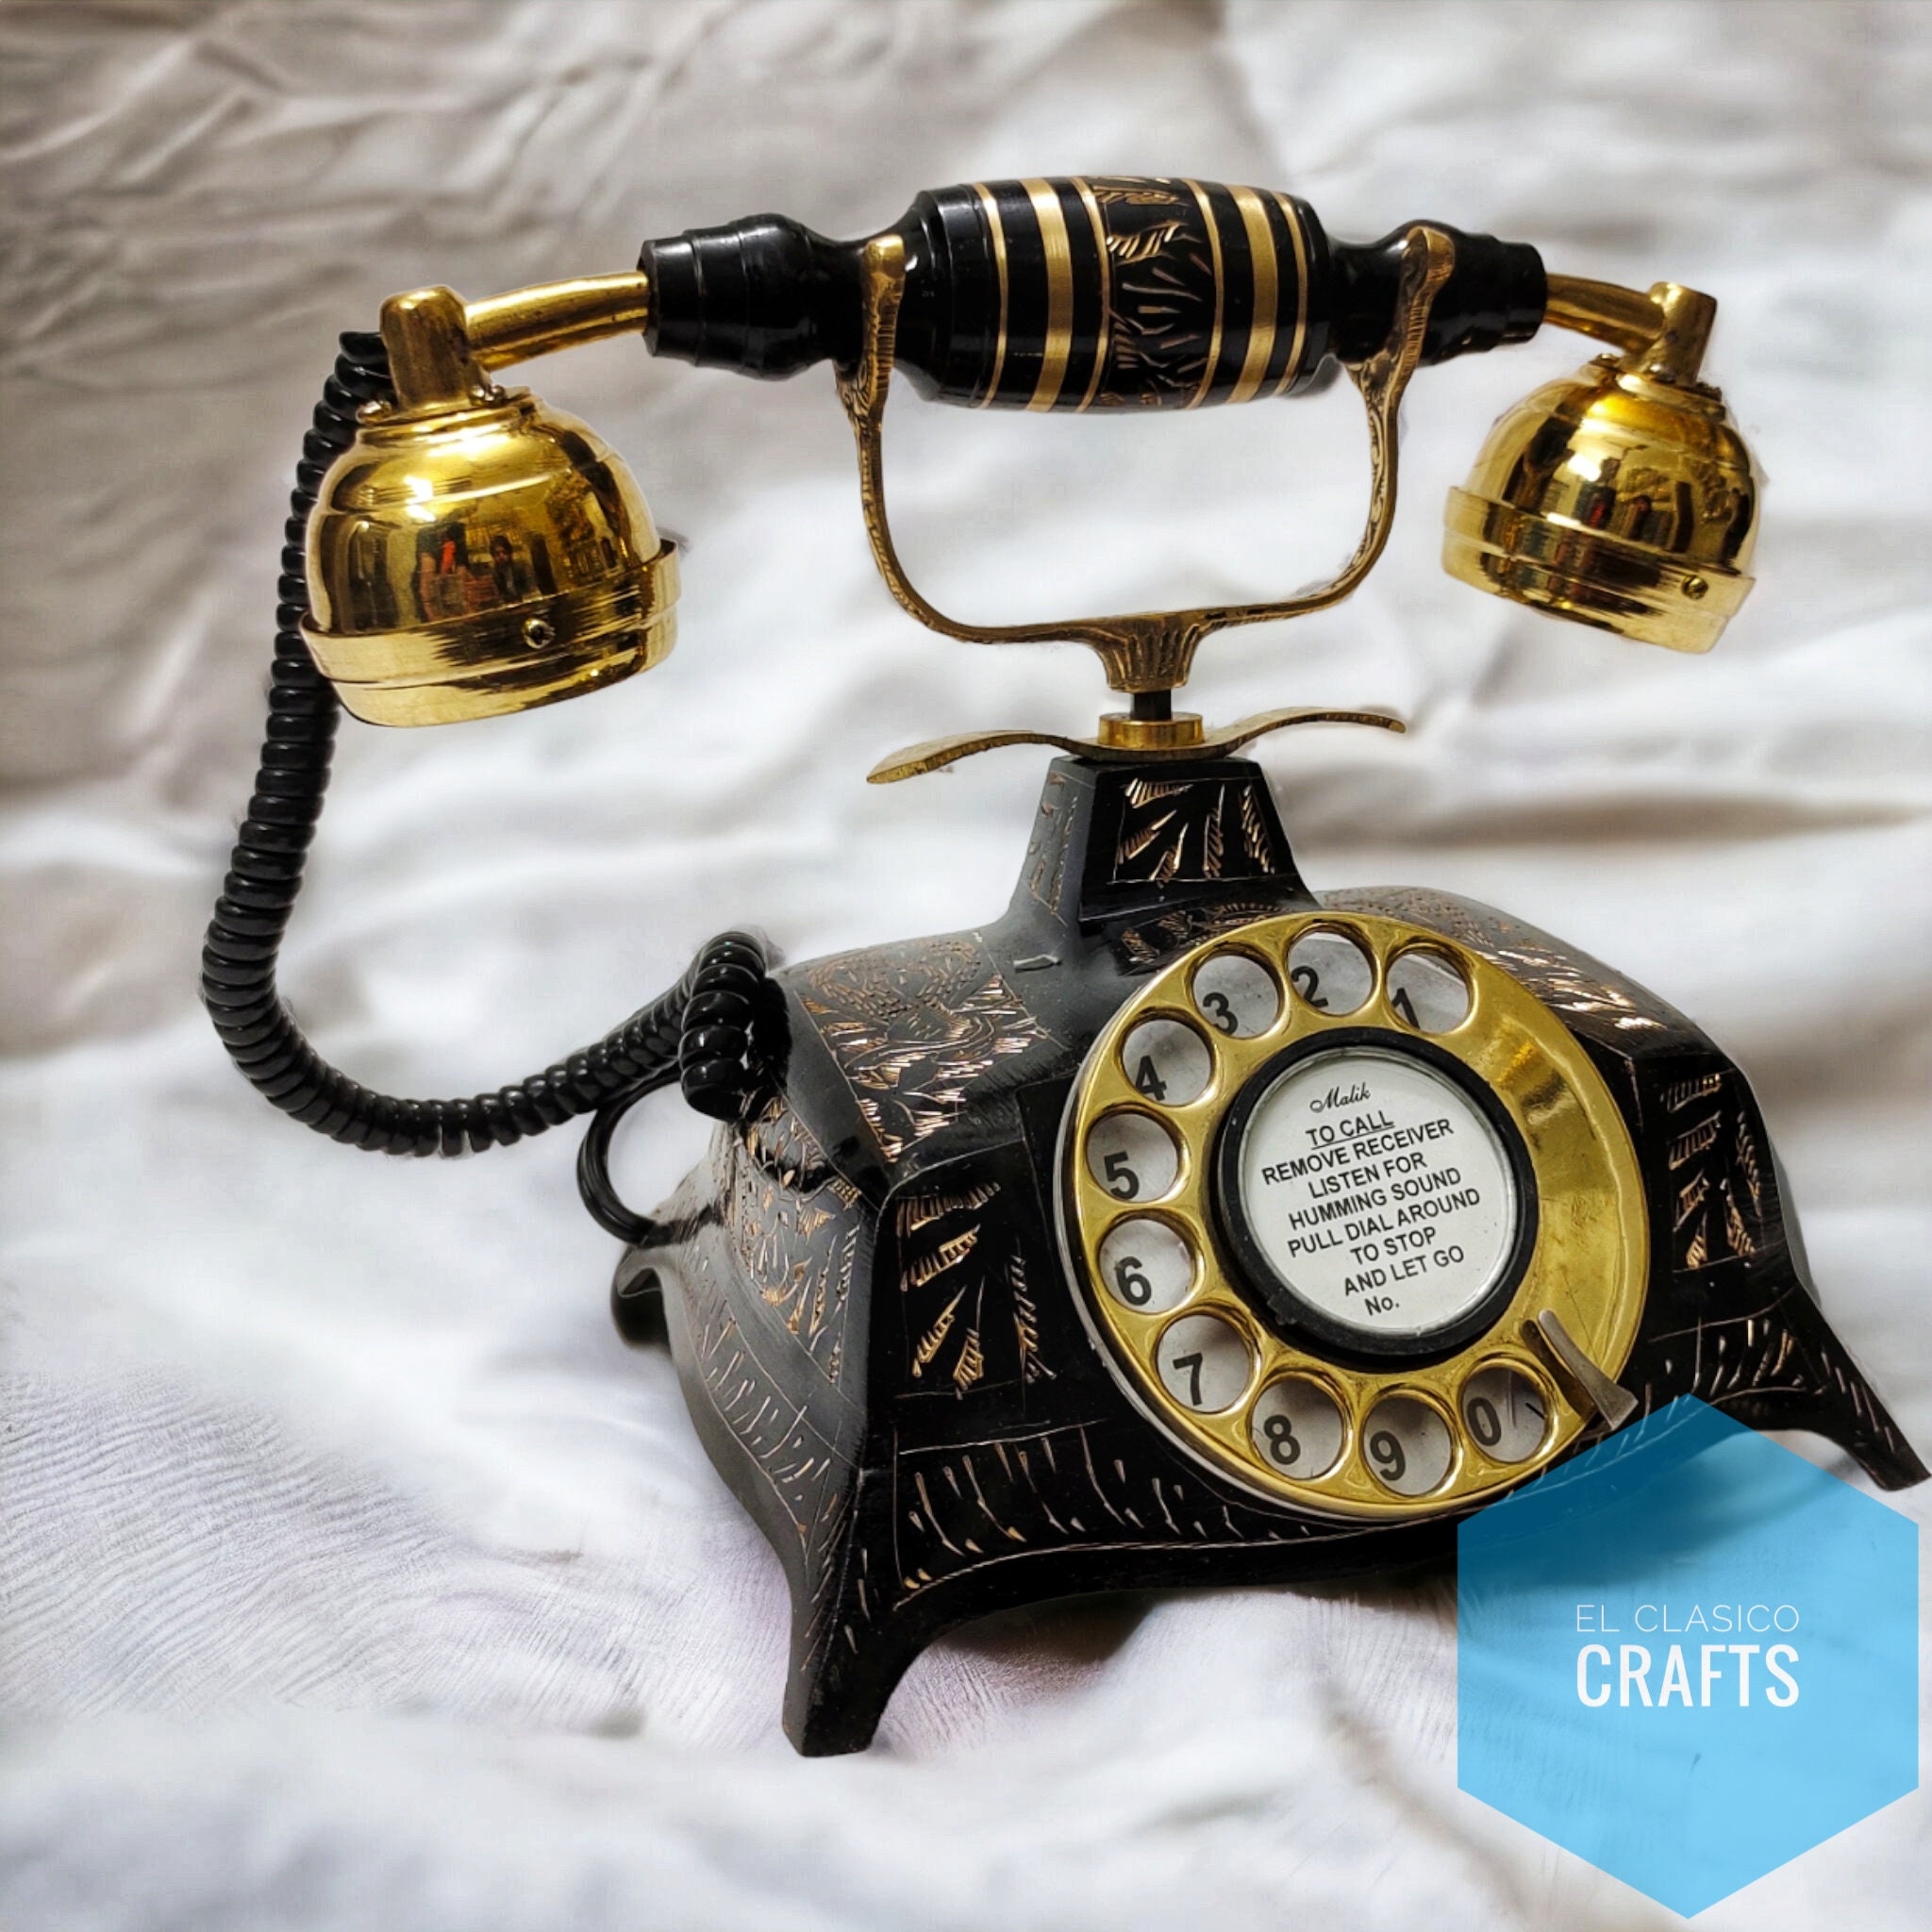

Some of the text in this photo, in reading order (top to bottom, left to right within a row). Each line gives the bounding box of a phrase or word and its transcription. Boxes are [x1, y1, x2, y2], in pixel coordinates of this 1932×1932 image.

[1291, 965, 1329, 1009] 2
[1392, 987, 1421, 1029] 1
[1202, 991, 1239, 1035] 3
[1133, 1056, 1168, 1102] 4
[1310, 1083, 1371, 1113] Malik
[1261, 1119, 1454, 1185] REMOVE RECEIVER
[1306, 1110, 1394, 1147] TO CALL
[1105, 1152, 1141, 1199] 5
[1288, 1167, 1462, 1231] HUMMING SOUND
[1307, 1151, 1427, 1199] LISTEN FOR
[1287, 1188, 1481, 1257] PULL DIAL AROUND
[1350, 1226, 1437, 1265] TO STOP
[1114, 1256, 1153, 1306] 6
[1343, 1245, 1464, 1296] AND LET GO
[1364, 1295, 1400, 1316] No.
[1172, 1353, 1206, 1407] 7
[1262, 1414, 1301, 1466] 8
[1467, 1397, 1503, 1447] 0
[1369, 1430, 1407, 1482] 9
